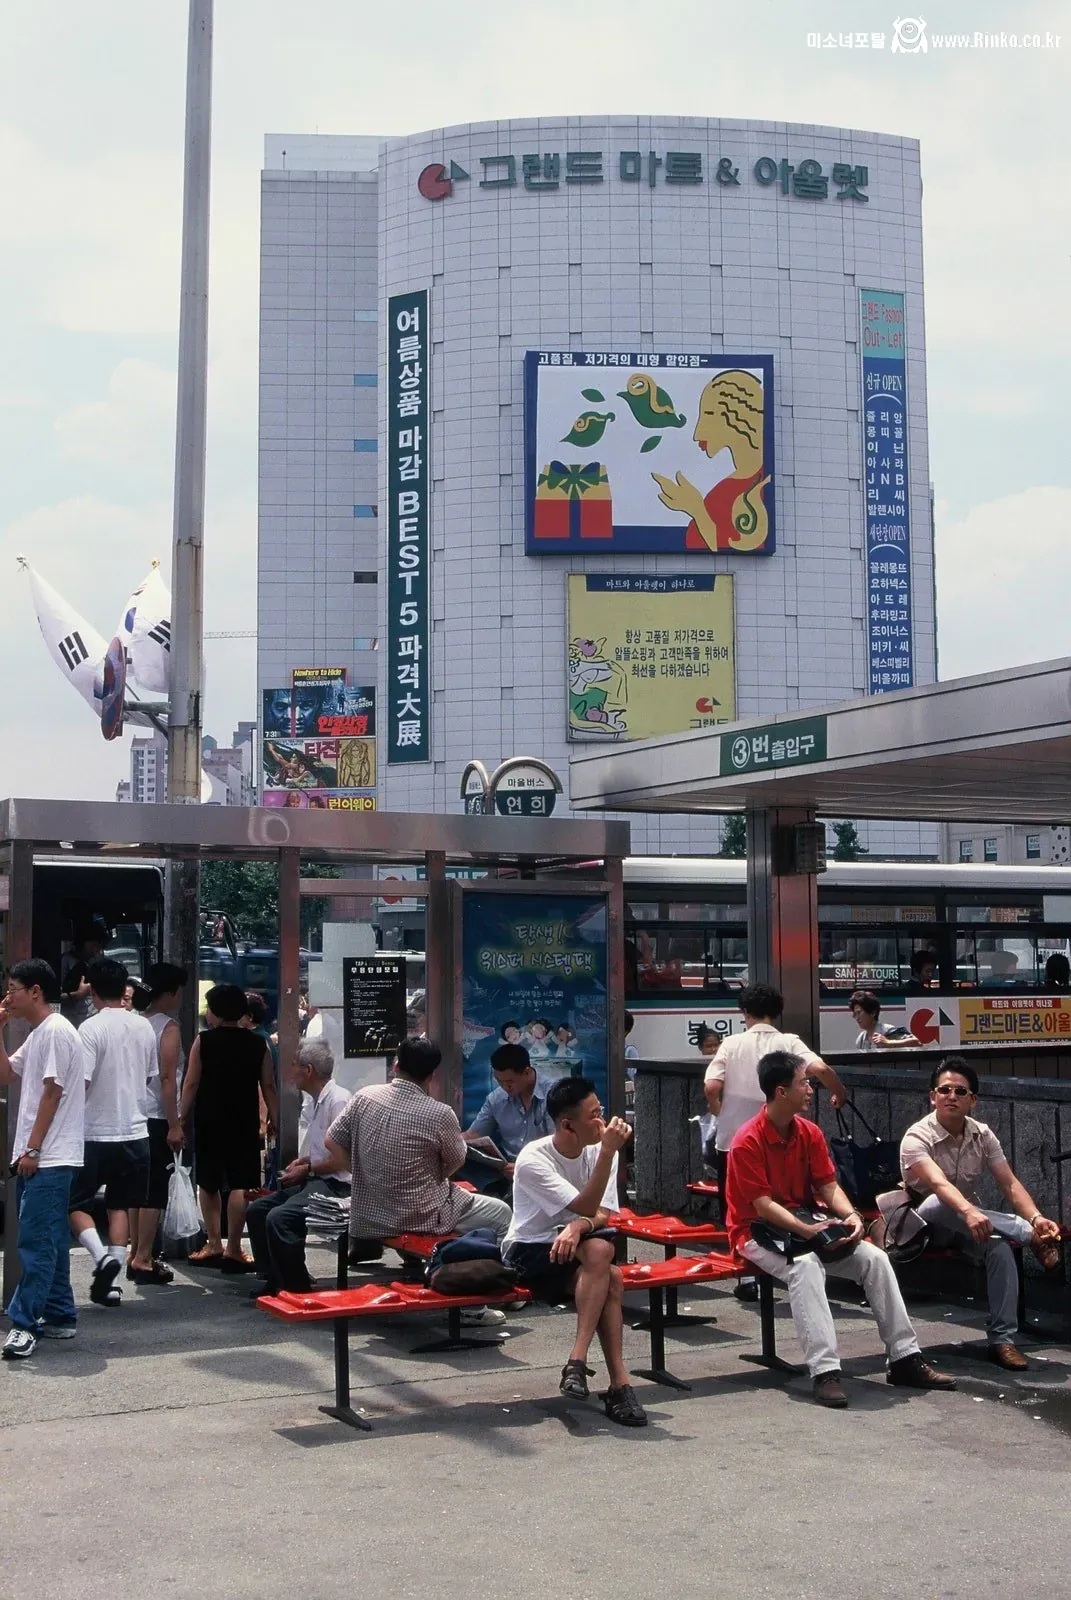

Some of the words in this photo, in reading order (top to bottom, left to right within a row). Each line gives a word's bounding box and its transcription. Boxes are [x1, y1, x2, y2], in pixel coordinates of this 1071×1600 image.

[479, 151, 604, 190] 그랜드
[619, 151, 704, 188] 마트
[716, 157, 741, 186] &
[754, 157, 869, 203] 아울렛
[396, 307, 422, 418] 여름상품
[585, 353, 632, 367] 저가격의
[636, 354, 660, 367] 대형
[866, 372, 880, 391] 신규
[882, 374, 903, 391] OPEN
[398, 425, 422, 482] 마감
[867, 504, 905, 517] 발렌시아
[606, 579, 631, 590] 마트와
[671, 579, 695, 590] 하나로
[871, 609, 908, 622] 후라밍고
[625, 629, 641, 644] 항상
[645, 630, 670, 645] 고품질
[674, 629, 715, 643] 저가격으로
[871, 625, 909, 637] 조이너스
[615, 646, 656, 661] 알뜰쇼핑과
[660, 646, 701, 660] 고객만족을
[704, 645, 729, 660] 위하여
[631, 664, 657, 678] 최선을
[661, 663, 710, 678] 다하겠습니다
[304, 741, 342, 759] 타잔
[507, 778, 545, 788] 마을버스
[328, 797, 376, 810] 런어웨이
[506, 795, 546, 815] 연희
[481, 951, 525, 971] 위스퍼
[834, 968, 869, 979] SANG-A
[871, 968, 899, 979] TOURS
